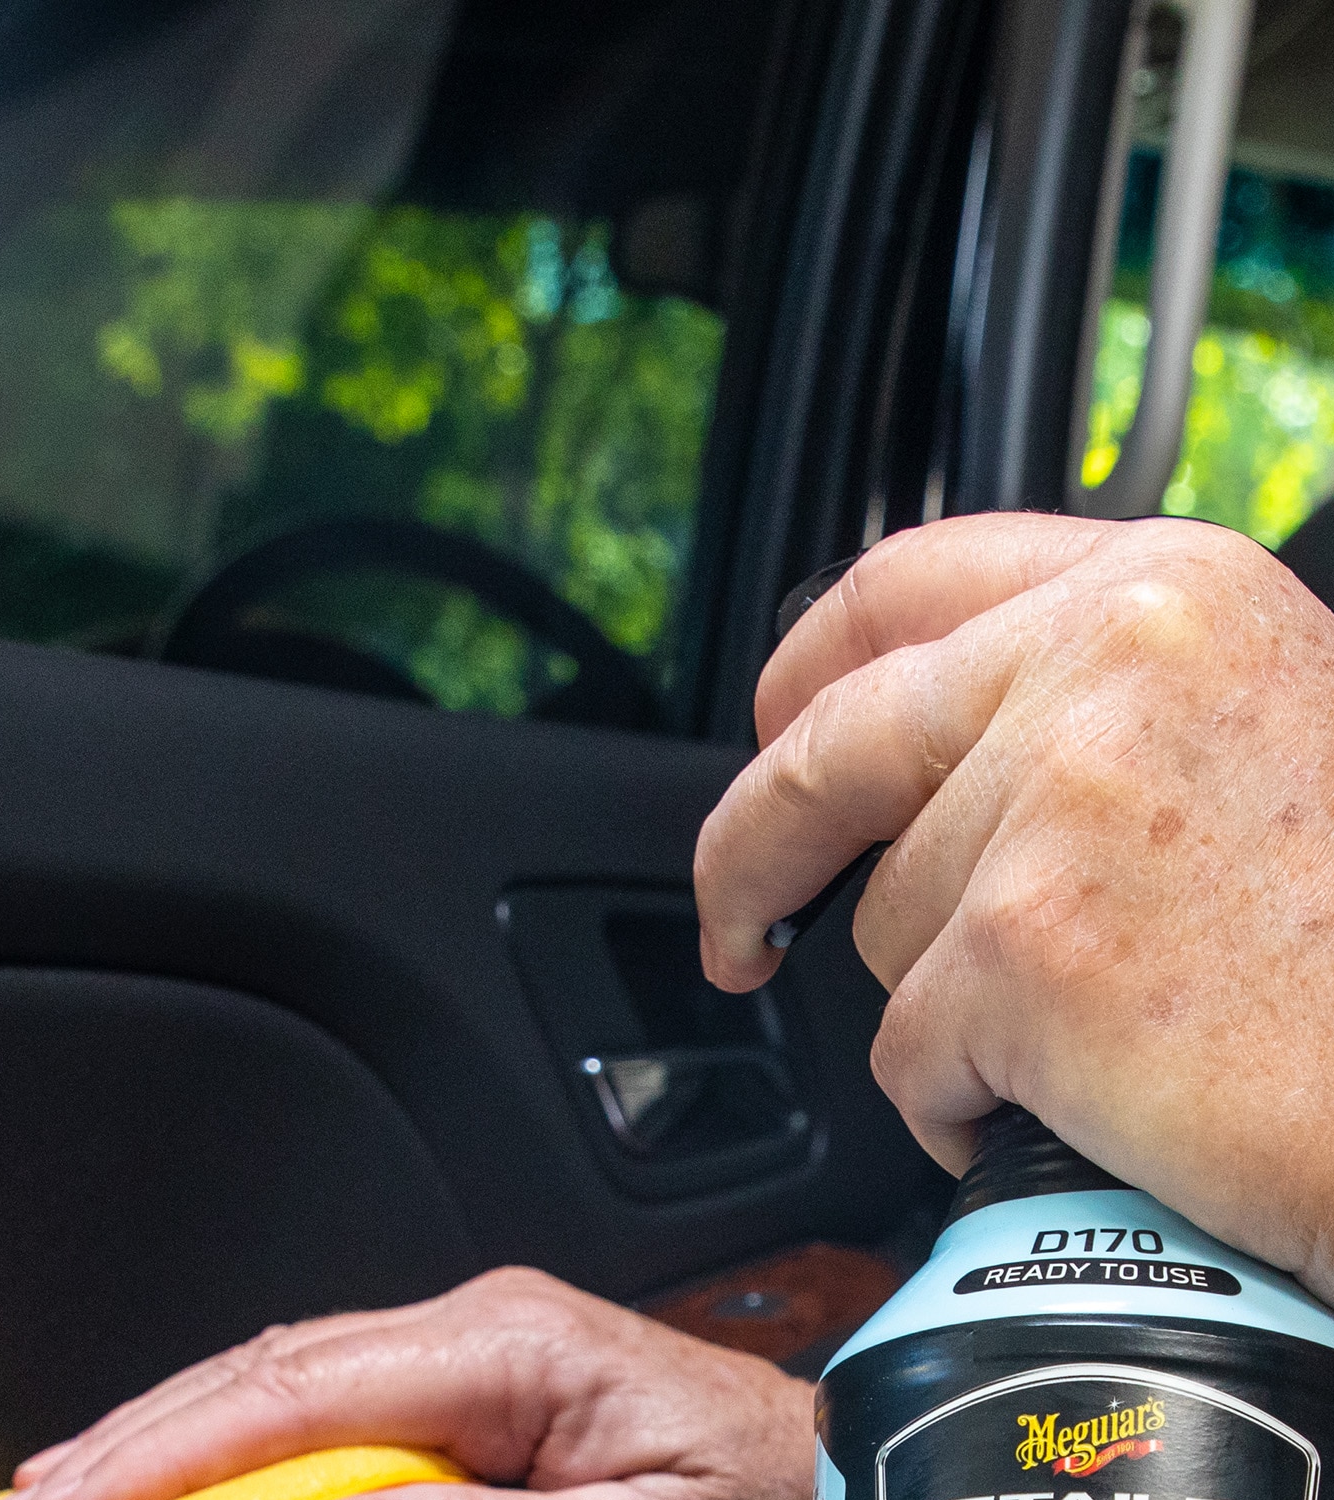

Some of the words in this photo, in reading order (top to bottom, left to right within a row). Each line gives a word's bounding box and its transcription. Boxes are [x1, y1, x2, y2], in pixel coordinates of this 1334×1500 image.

[1030, 1228, 1164, 1255] D170
[983, 1262, 1091, 1286] READY
[1099, 1262, 1138, 1281] TO
[1148, 1266, 1209, 1287] USE
[1015, 1396, 1167, 1474] Meguiar's
